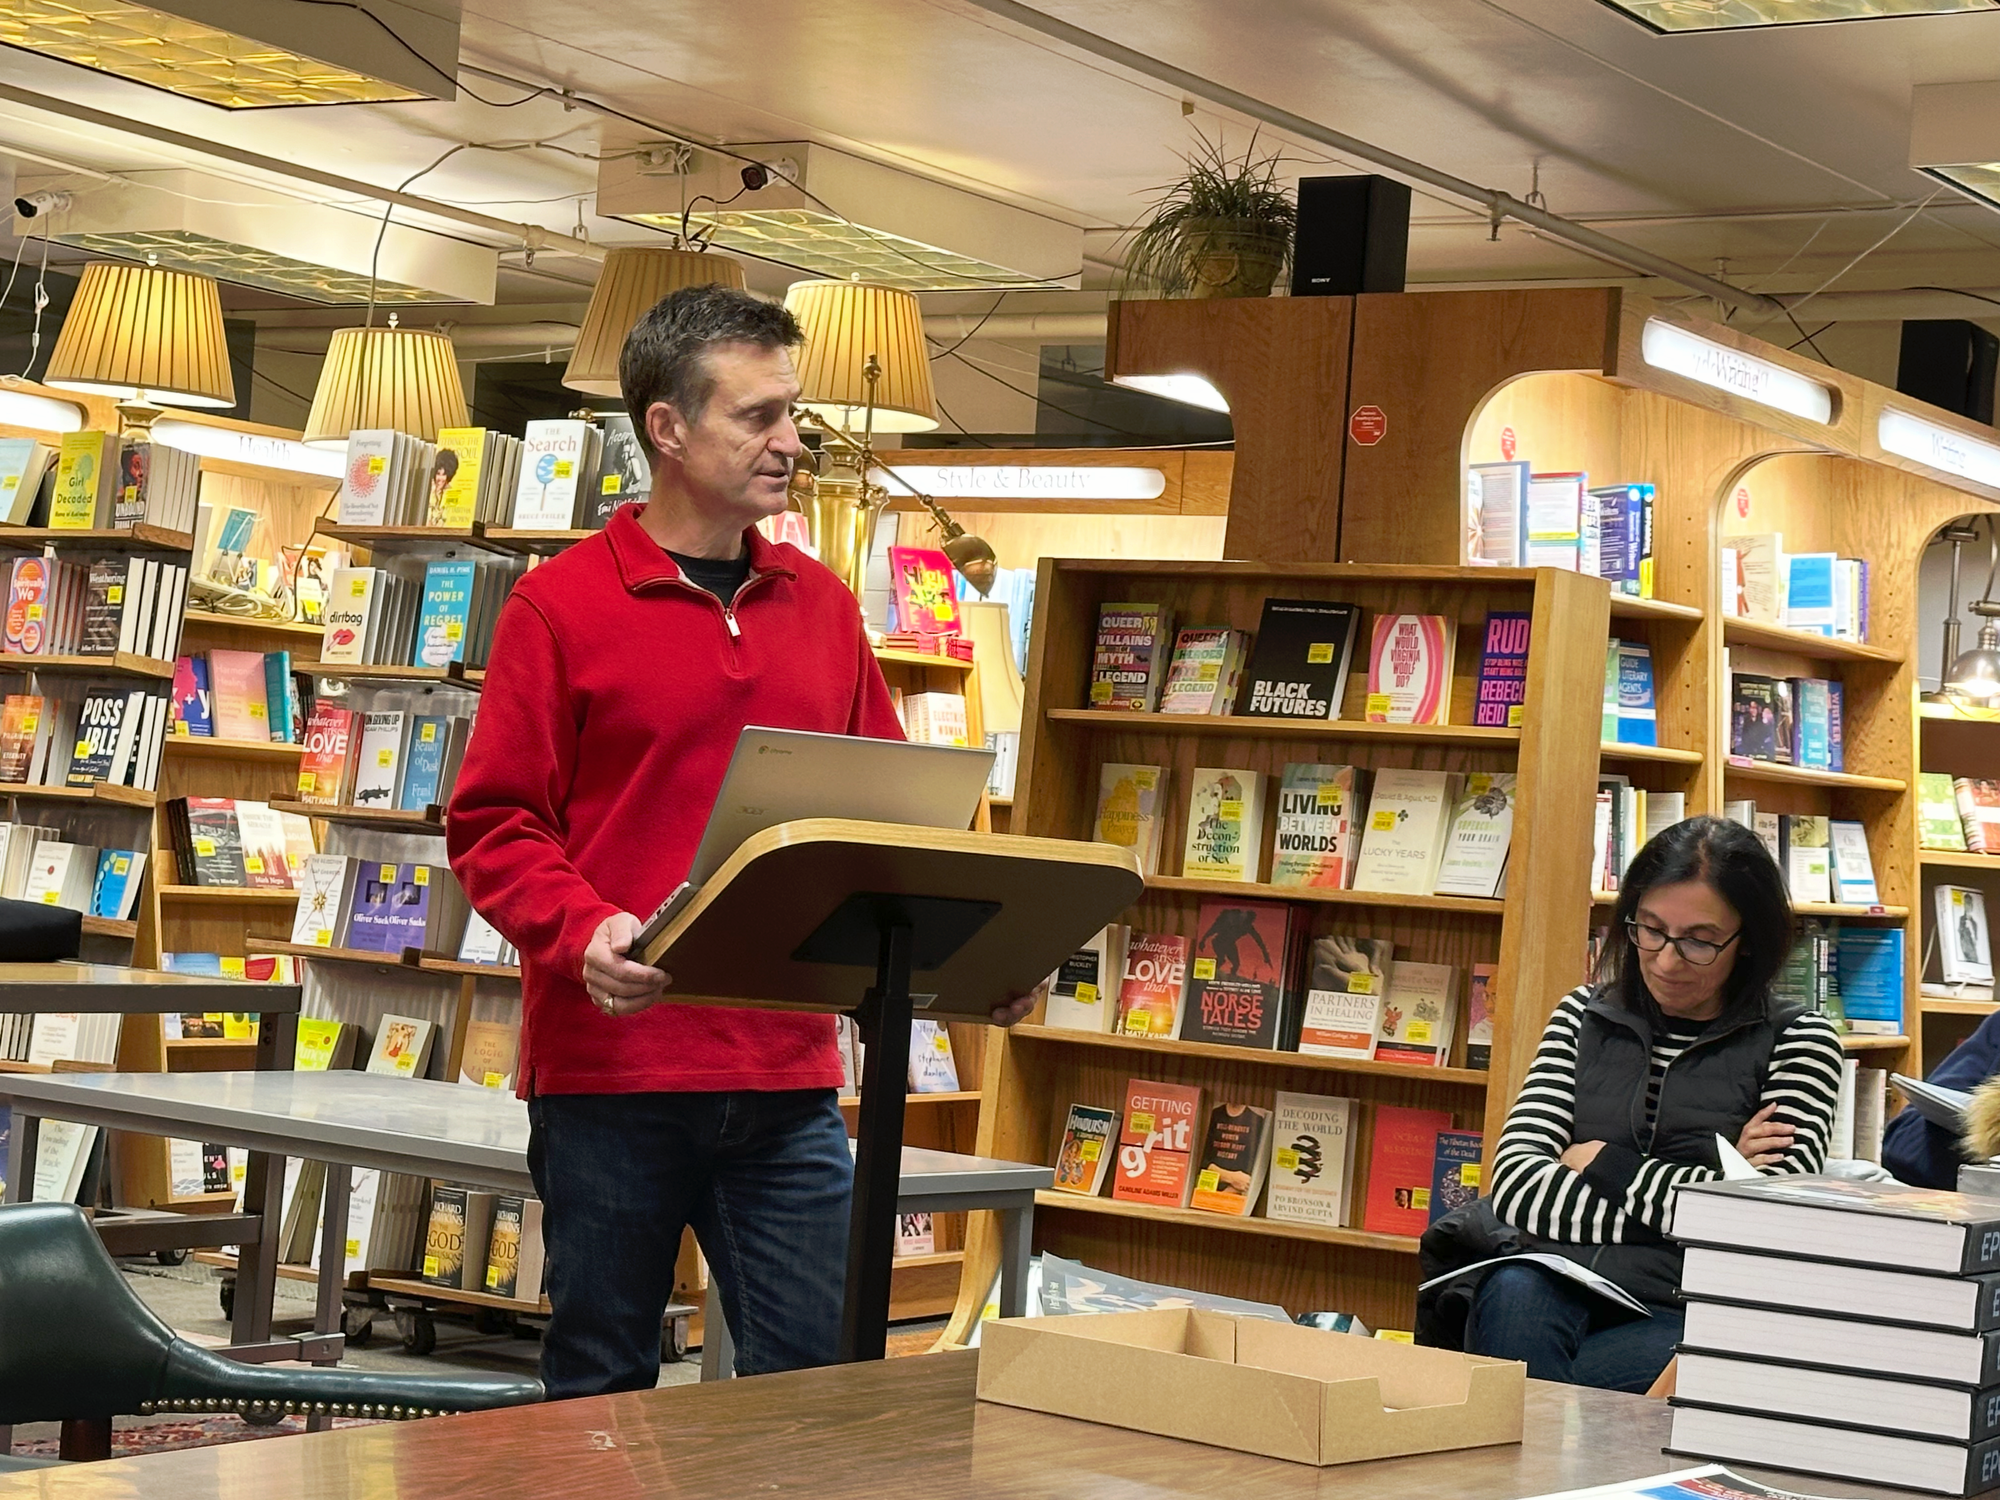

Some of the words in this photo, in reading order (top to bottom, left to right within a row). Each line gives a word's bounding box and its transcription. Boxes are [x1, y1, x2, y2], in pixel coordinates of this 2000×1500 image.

[239, 436, 291, 461] Health
[527, 435, 576, 452] Search
[456, 448, 478, 459] SOUL
[69, 476, 84, 487] Girl
[937, 467, 987, 489] Style
[993, 467, 1010, 489] &
[1018, 467, 1091, 490] Beauty
[57, 493, 93, 504] Decoded
[89, 573, 126, 585] Weathering
[441, 580, 454, 588] THE
[17, 588, 34, 600] We
[428, 591, 464, 602] POWER
[439, 605, 448, 613] OF
[329, 611, 363, 626] dirtbag
[424, 614, 462, 626] REGRET
[1102, 617, 1142, 628] QUEER
[1398, 623, 1418, 636] WHAT
[1098, 634, 1152, 646] VILLAINS
[1394, 636, 1419, 649] WOULD
[1097, 653, 1134, 665] MYTH
[1390, 649, 1420, 662] VIRGINIA
[1393, 662, 1415, 674] WOOLF
[1621, 657, 1638, 668] GUIDE
[1100, 671, 1147, 683] LEGEND
[1395, 675, 1410, 688] DO?
[1622, 670, 1648, 681] LITERARY
[1171, 682, 1214, 692] LEGEND
[1253, 680, 1311, 699] BLACK
[1620, 682, 1642, 693] AGENTS
[197, 689, 209, 719] y
[1250, 696, 1327, 716] FUTURES
[80, 697, 124, 727] POSS
[933, 710, 964, 723] ELECTRIC
[1477, 703, 1506, 725] REID
[308, 712, 344, 727] whatever
[391, 714, 400, 725] UP
[938, 725, 962, 736] WOMAN
[302, 732, 348, 755] LOVE
[414, 739, 439, 755] Beauty
[316, 749, 335, 763] that
[414, 753, 425, 766] of
[422, 759, 440, 773] Dusk
[412, 783, 432, 798] Frank
[1374, 792, 1396, 800] David
[1282, 793, 1342, 817] LIVING
[1099, 808, 1150, 823] Happiness
[1208, 817, 1229, 830] The
[1280, 816, 1341, 834] BETWEEN
[1279, 833, 1338, 853] WORLDS
[1458, 833, 1476, 842] YOUR
[1191, 843, 1240, 856] struction
[1362, 847, 1394, 857] LUCKY
[1395, 849, 1426, 860] YEARS
[1198, 854, 1210, 864] of
[1211, 852, 1231, 865] Sex
[354, 913, 373, 923] Oliver
[389, 914, 408, 925] Oliver
[408, 917, 426, 926] Sacks
[1130, 938, 1183, 956] whatever
[1153, 953, 1186, 965] arises
[1123, 957, 1186, 985] LOVE
[1143, 979, 1169, 994] that
[1201, 990, 1264, 1013] NORSE
[1312, 992, 1376, 1009] PARTNERS
[1202, 1007, 1262, 1029] TALES
[1310, 1005, 1321, 1015] IN
[1322, 1007, 1373, 1020] HEALING
[1125, 1030, 1146, 1038] MATT
[474, 1048, 504, 1058] LOGIC
[1131, 1095, 1192, 1115] GETTING
[1282, 1108, 1340, 1124] DECODING
[53, 1124, 64, 1133] The
[1069, 1114, 1110, 1135] HINDUISM
[1277, 1119, 1298, 1132] THE
[1303, 1123, 1343, 1136] WORLD
[1439, 1136, 1449, 1145] The
[1449, 1138, 1469, 1147] Tibetan
[1120, 1118, 1190, 1179] grit
[1451, 1148, 1460, 1157] the
[1460, 1150, 1476, 1159] Dead
[1118, 1185, 1142, 1194] CAROLINE
[1143, 1187, 1161, 1197] ADAMS
[1161, 1190, 1179, 1199] MILLER
[434, 1201, 462, 1214] RICHARD
[1275, 1194, 1285, 1202] PO
[1286, 1196, 1324, 1208] BRONSON
[1272, 1203, 1304, 1214] ARVIND
[1306, 1207, 1333, 1218] GUPTA
[428, 1230, 462, 1251] GOD
[491, 1239, 518, 1259] GOD
